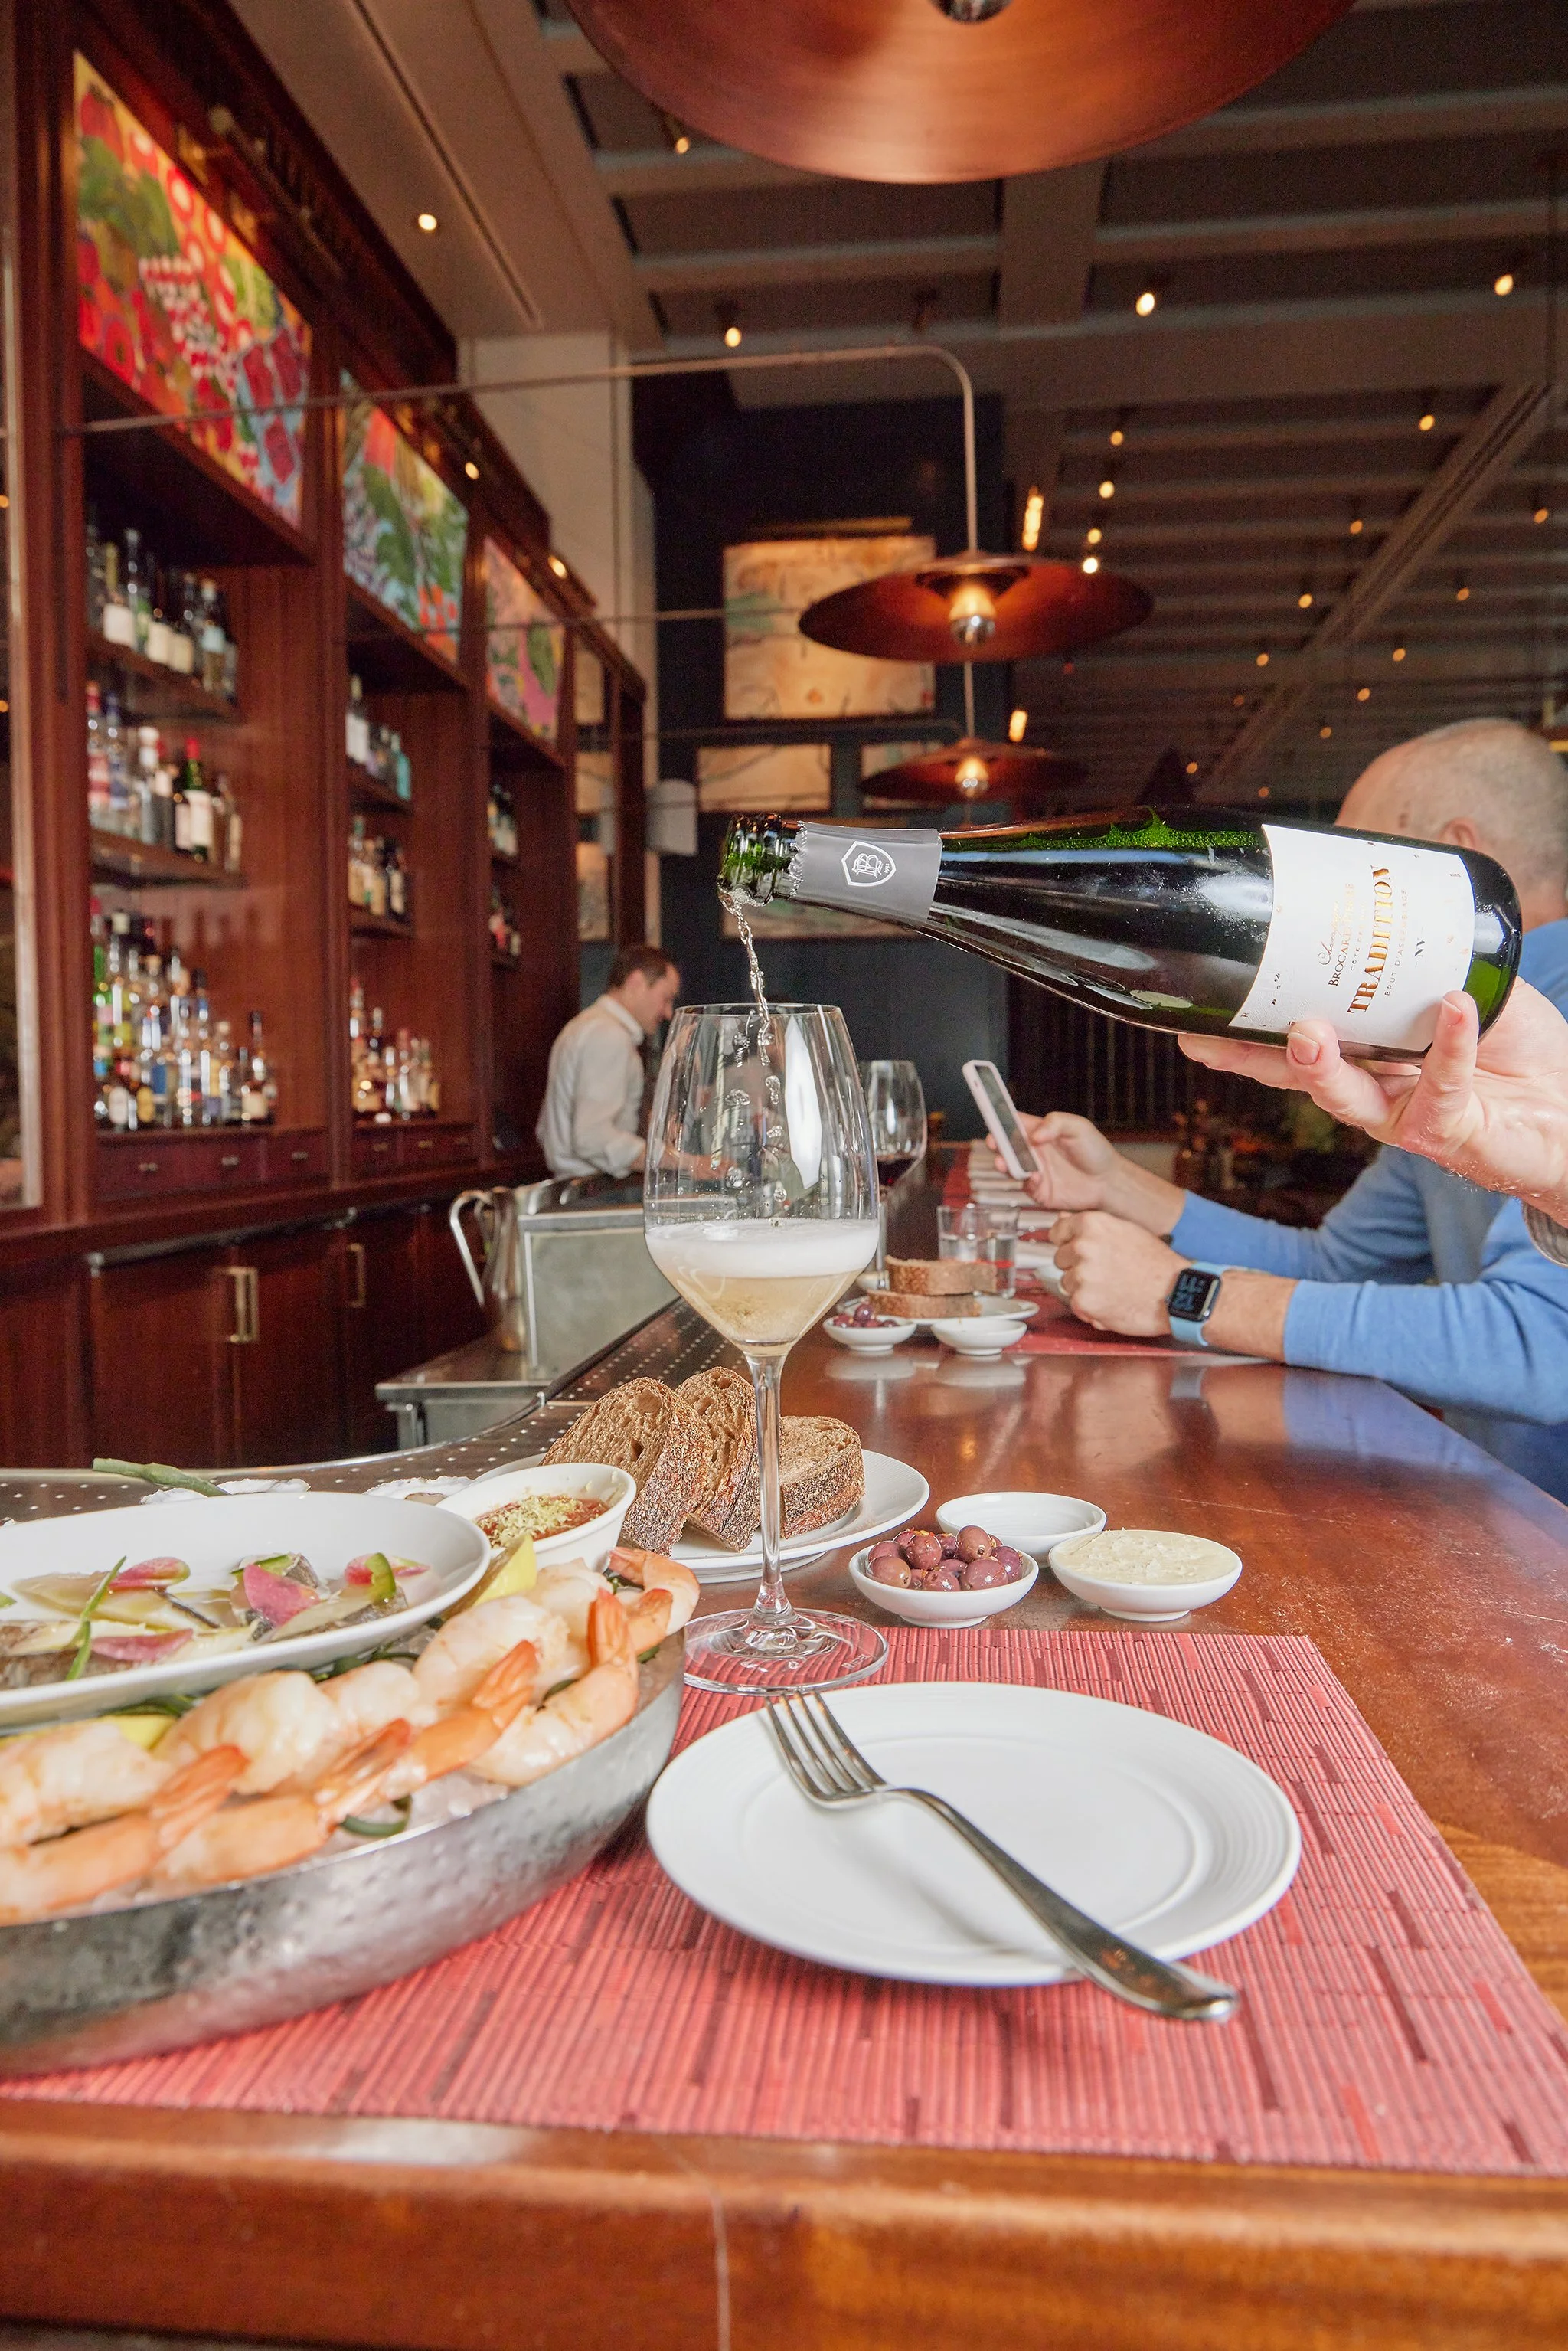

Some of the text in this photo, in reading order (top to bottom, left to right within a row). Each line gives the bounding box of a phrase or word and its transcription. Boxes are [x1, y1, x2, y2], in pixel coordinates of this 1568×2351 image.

[1327, 928, 1352, 986] BROCARD
[1347, 863, 1393, 1015] TRADITION
[1384, 971, 1397, 996] BRUT
